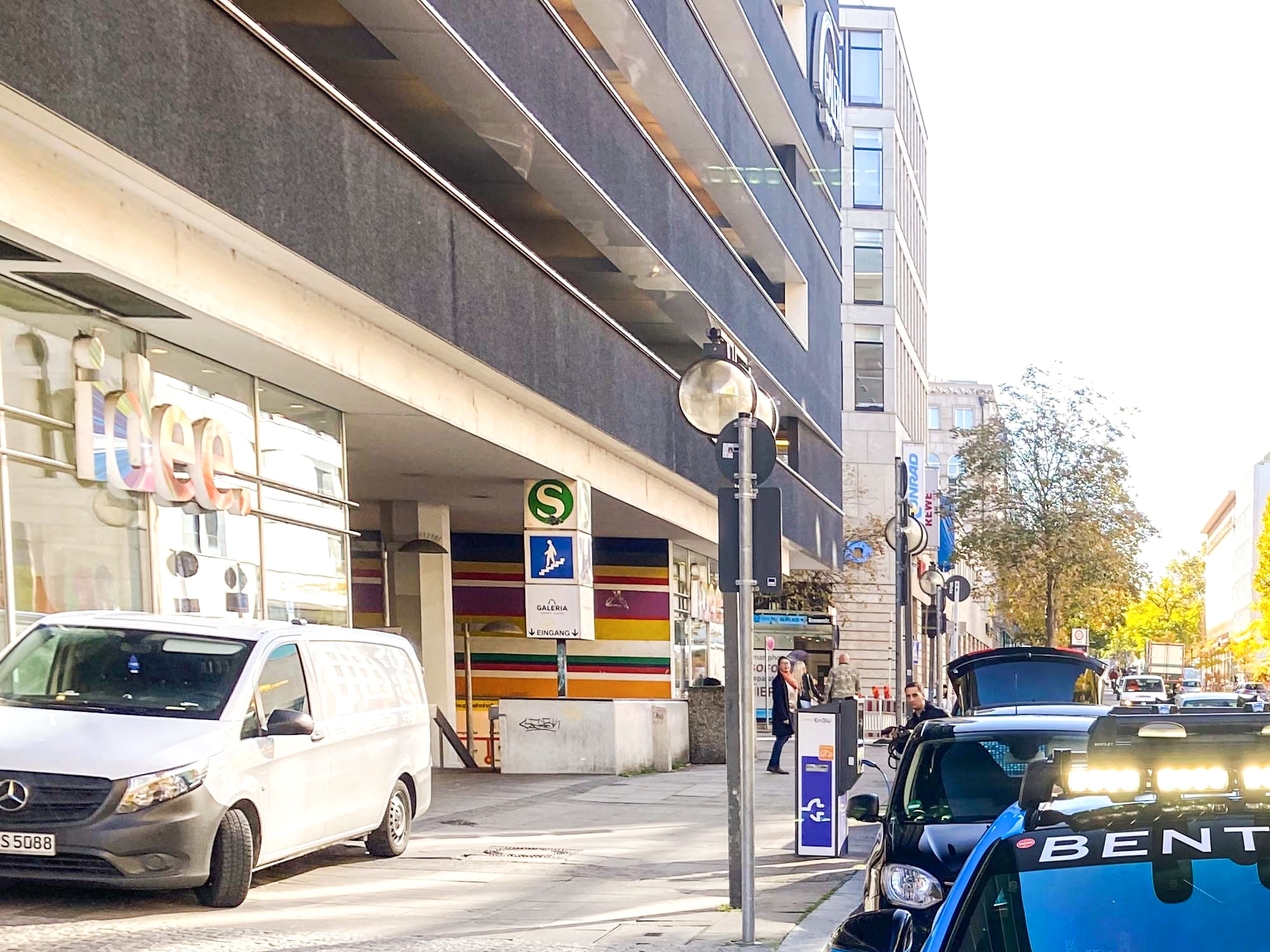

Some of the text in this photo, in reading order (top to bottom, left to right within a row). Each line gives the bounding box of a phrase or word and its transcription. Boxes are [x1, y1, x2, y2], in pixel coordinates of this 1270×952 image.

[536, 604, 568, 612] GALERIA
[536, 629, 571, 637] EINGANG
[13, 835, 52, 850] 5088
